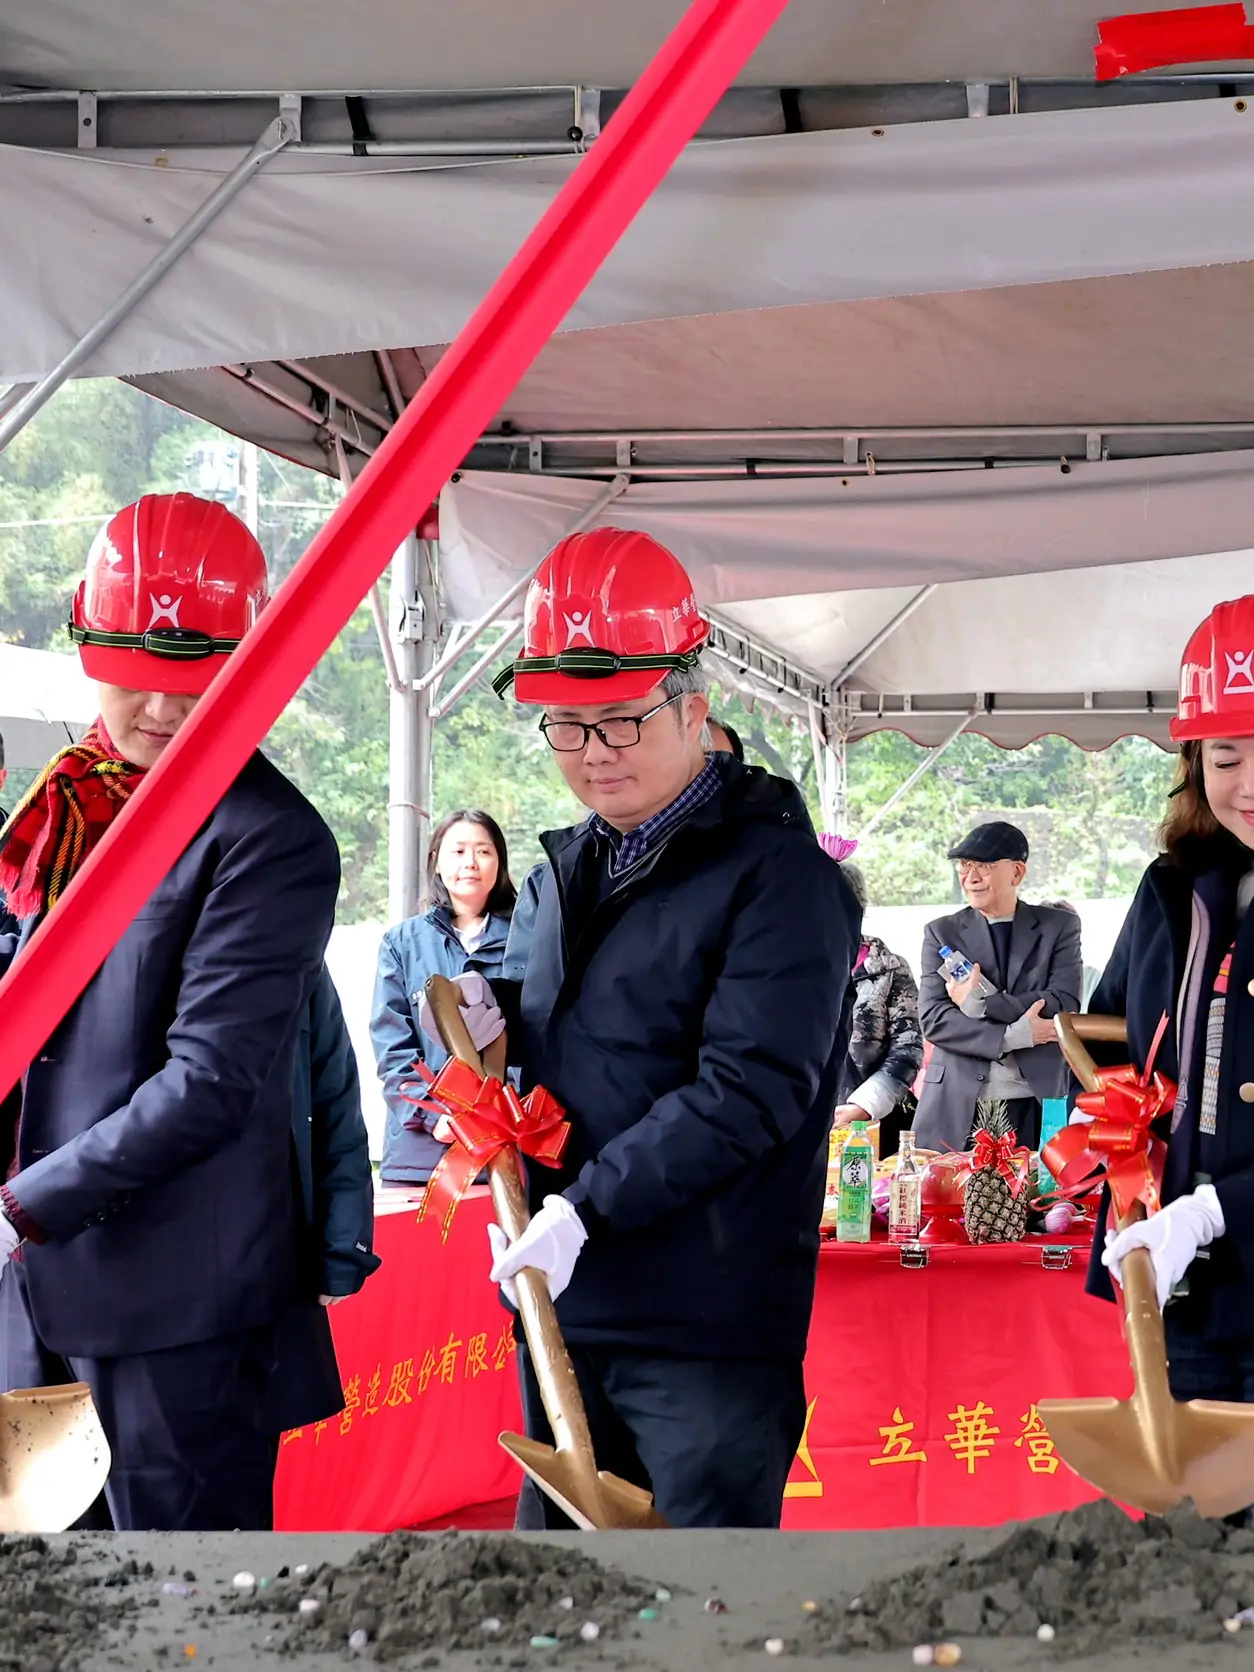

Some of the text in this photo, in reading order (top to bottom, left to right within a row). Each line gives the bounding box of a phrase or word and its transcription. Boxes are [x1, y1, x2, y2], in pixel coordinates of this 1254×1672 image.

[283, 1319, 517, 1445] 營造股份有限公
